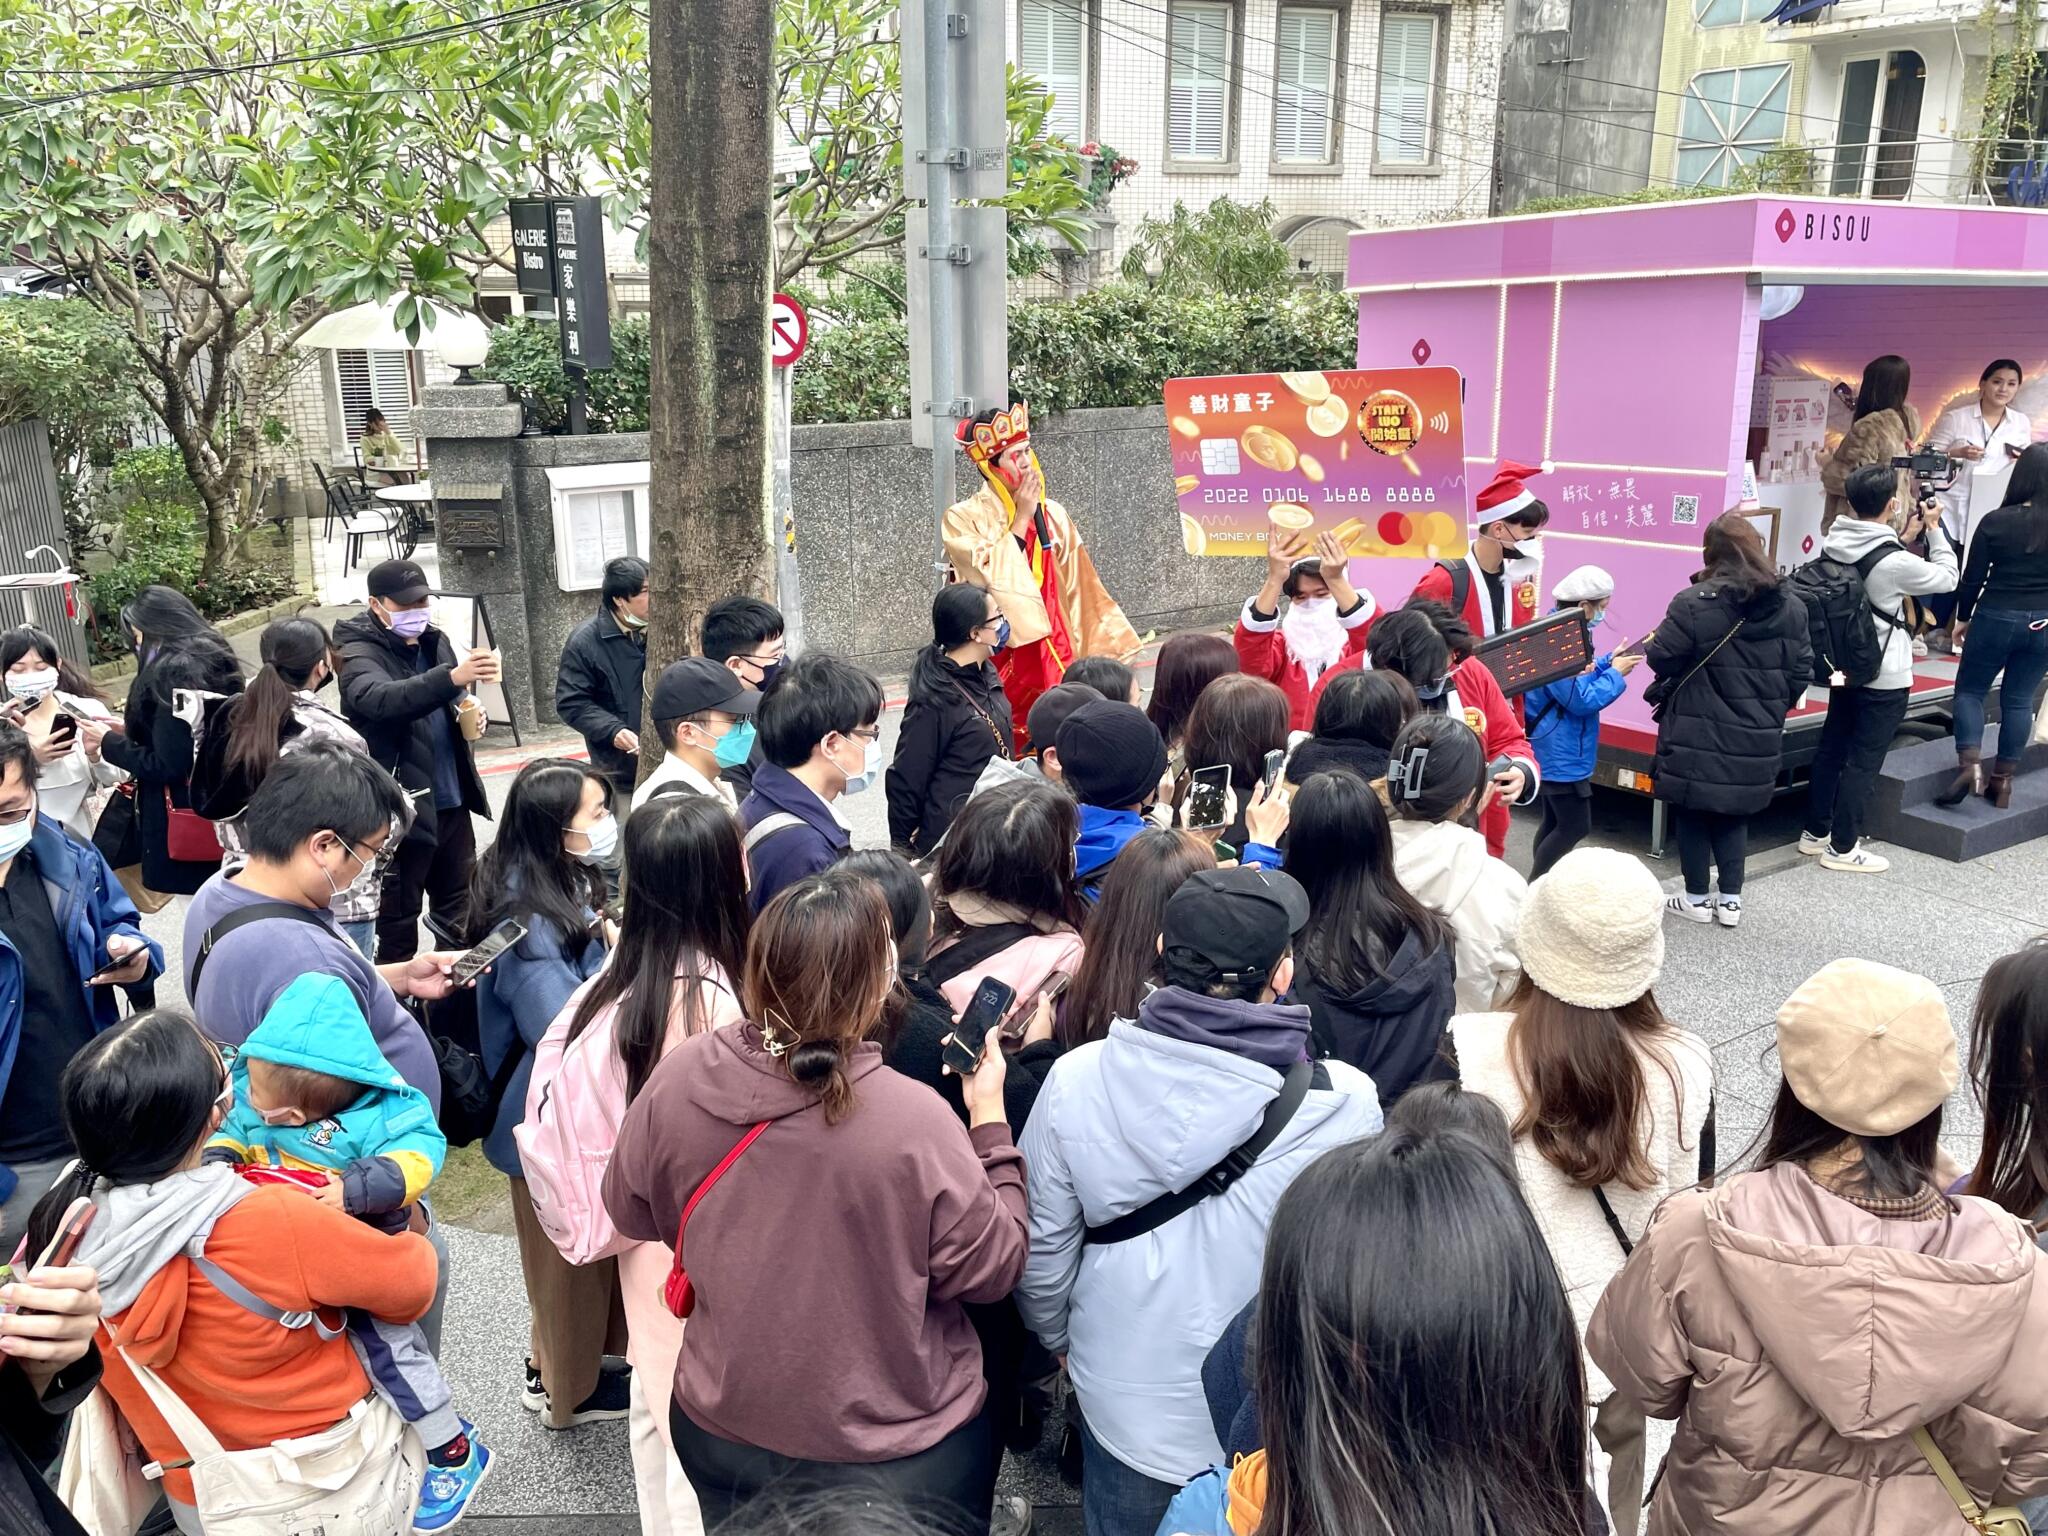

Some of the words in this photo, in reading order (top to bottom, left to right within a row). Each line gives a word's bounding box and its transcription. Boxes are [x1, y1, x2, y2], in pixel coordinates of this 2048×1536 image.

[1804, 212, 1871, 242] BISOU
[514, 229, 548, 247] GALERIE
[523, 252, 544, 270] Bistro
[1189, 392, 1275, 415] 善財童子
[1371, 404, 1408, 417] START
[1203, 488, 1249, 503] 2022
[1262, 487, 1309, 503] 0106
[1323, 487, 1371, 502] 1688
[1386, 487, 1436, 502] 8888
[1209, 532, 1252, 542] MONEY
